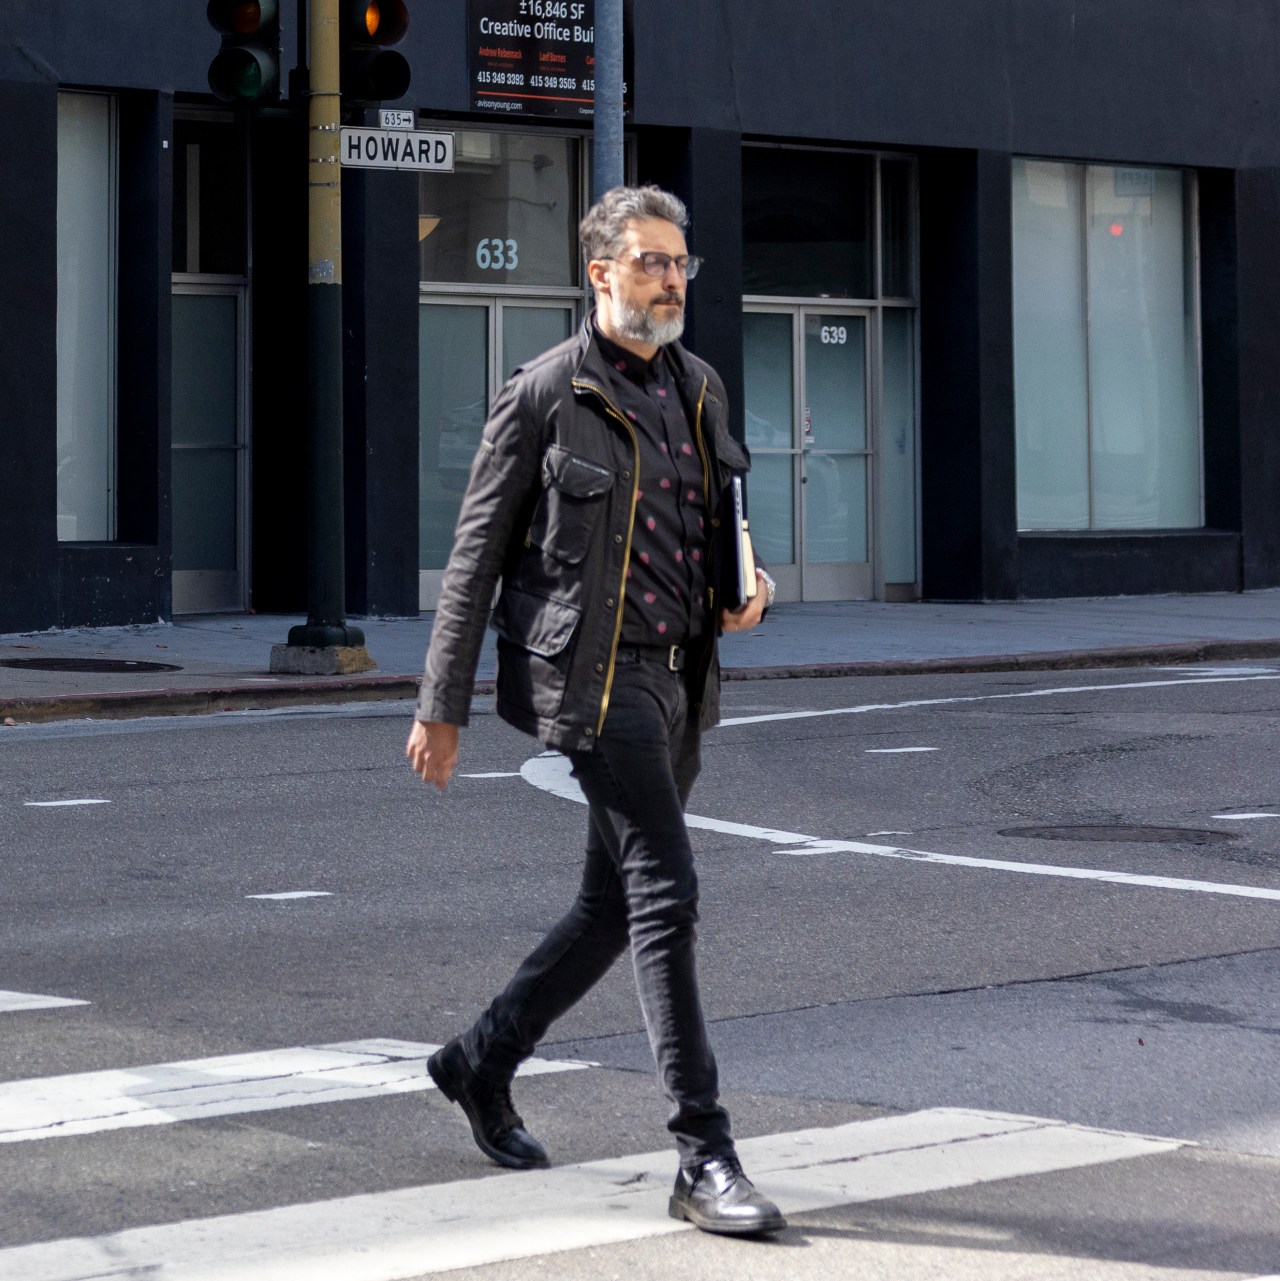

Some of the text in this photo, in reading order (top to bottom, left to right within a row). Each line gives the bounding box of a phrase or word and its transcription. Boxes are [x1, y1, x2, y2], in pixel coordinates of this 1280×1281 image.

[571, 3, 585, 19] SF
[480, 17, 594, 43] Creative Office Bui
[477, 71, 524, 85] 415 349 3392
[530, 76, 576, 89] 415 349 3505
[582, 80, 595, 91] 415
[477, 99, 522, 111] avisonyoung.com
[384, 113, 402, 125] 635
[348, 135, 447, 164] HOWARD
[476, 238, 518, 270] 633
[821, 326, 847, 344] 639
